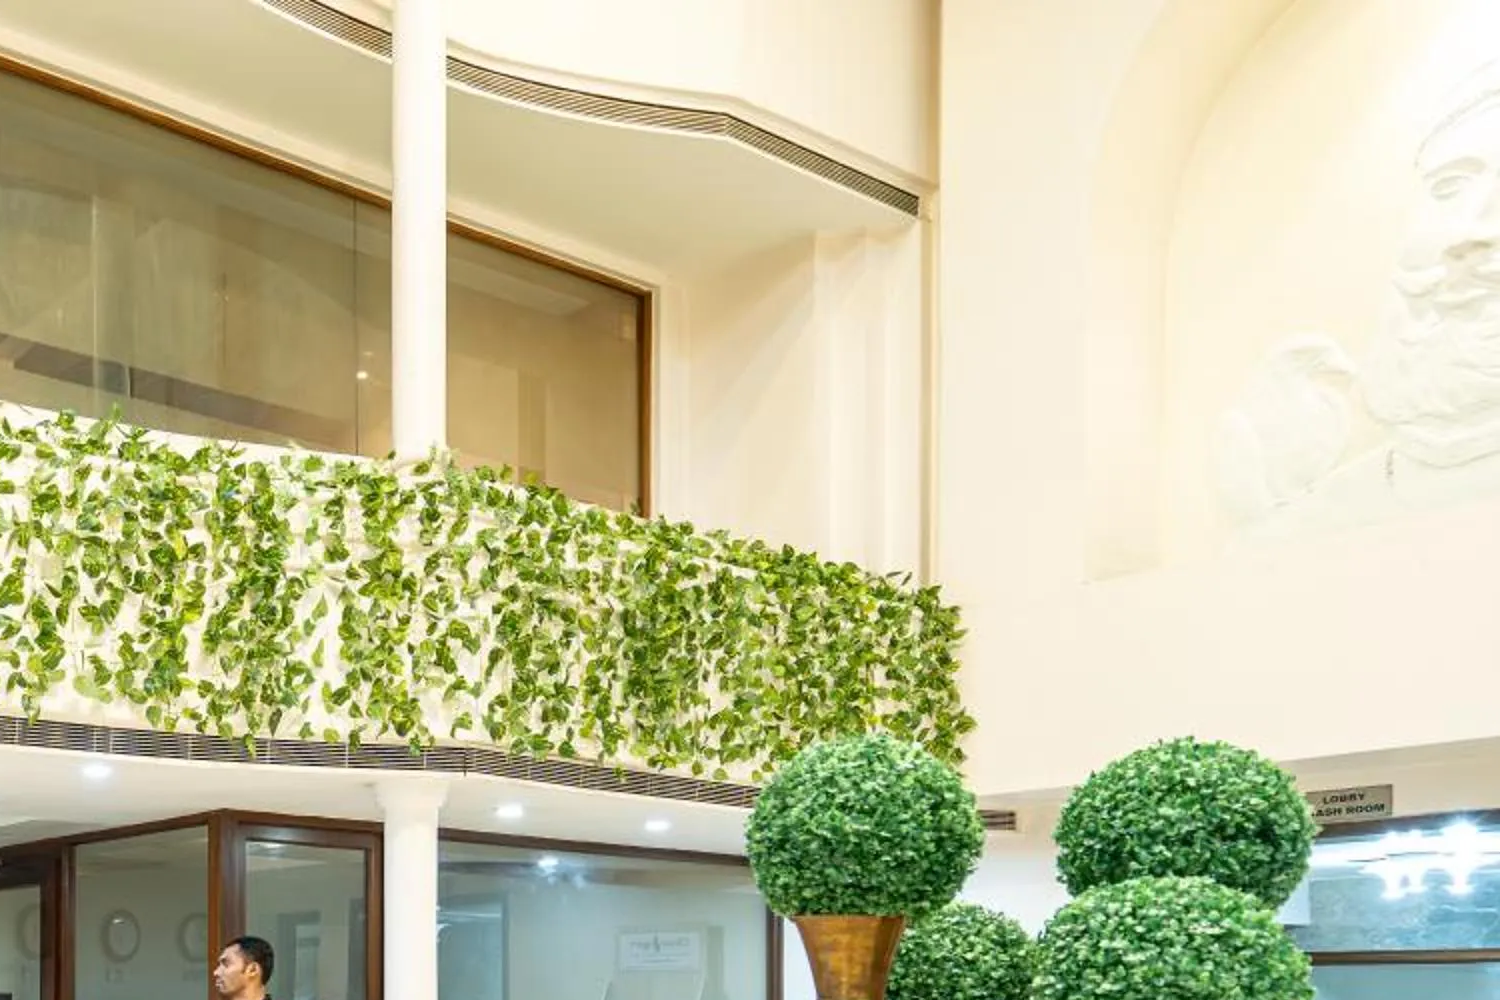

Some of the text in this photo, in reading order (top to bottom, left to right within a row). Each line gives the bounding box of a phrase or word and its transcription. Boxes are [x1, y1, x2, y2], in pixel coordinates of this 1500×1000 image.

[1323, 793, 1365, 804] LOBBY
[1311, 803, 1385, 817] ASH ROOM
